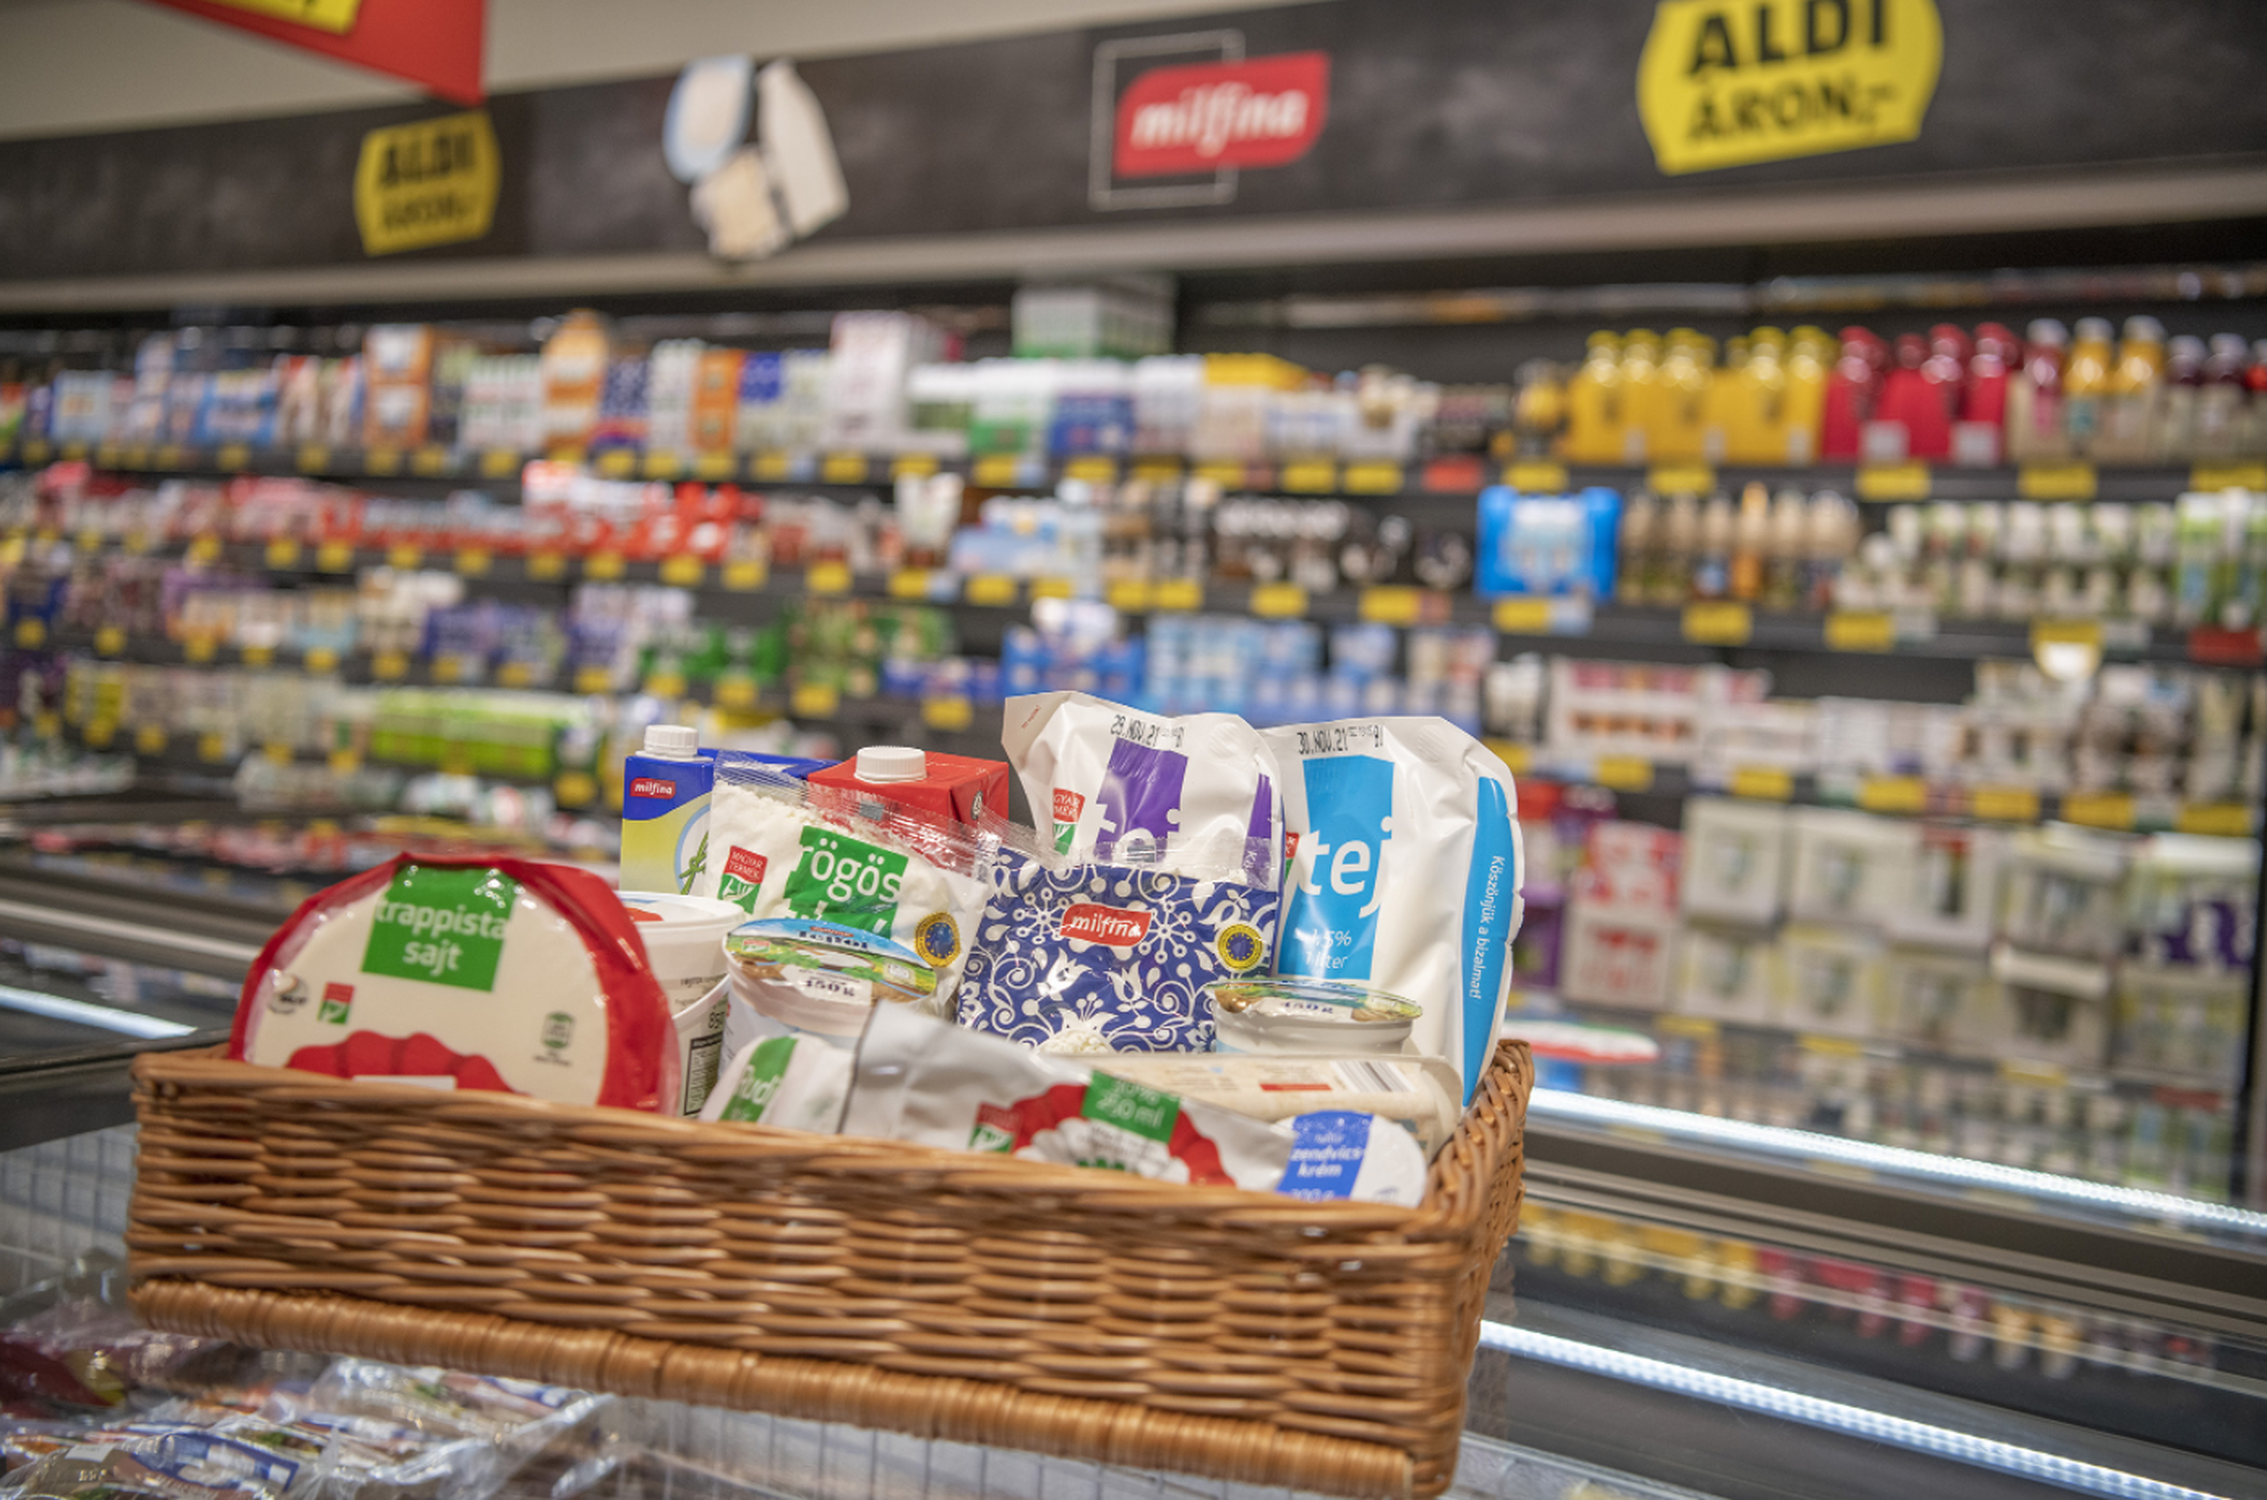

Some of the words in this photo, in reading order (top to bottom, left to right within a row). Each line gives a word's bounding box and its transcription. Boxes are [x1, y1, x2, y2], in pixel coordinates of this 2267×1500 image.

[1686, 0, 1888, 75] ALDI
[1131, 81, 1308, 158] milfina
[634, 781, 673, 795] milfina
[1298, 815, 1393, 919] tej
[1480, 855, 1505, 924] Köszönjük
[375, 897, 506, 940] trappista
[1072, 913, 1141, 938] milfina
[1478, 926, 1489, 935] a
[402, 938, 463, 977] sajt
